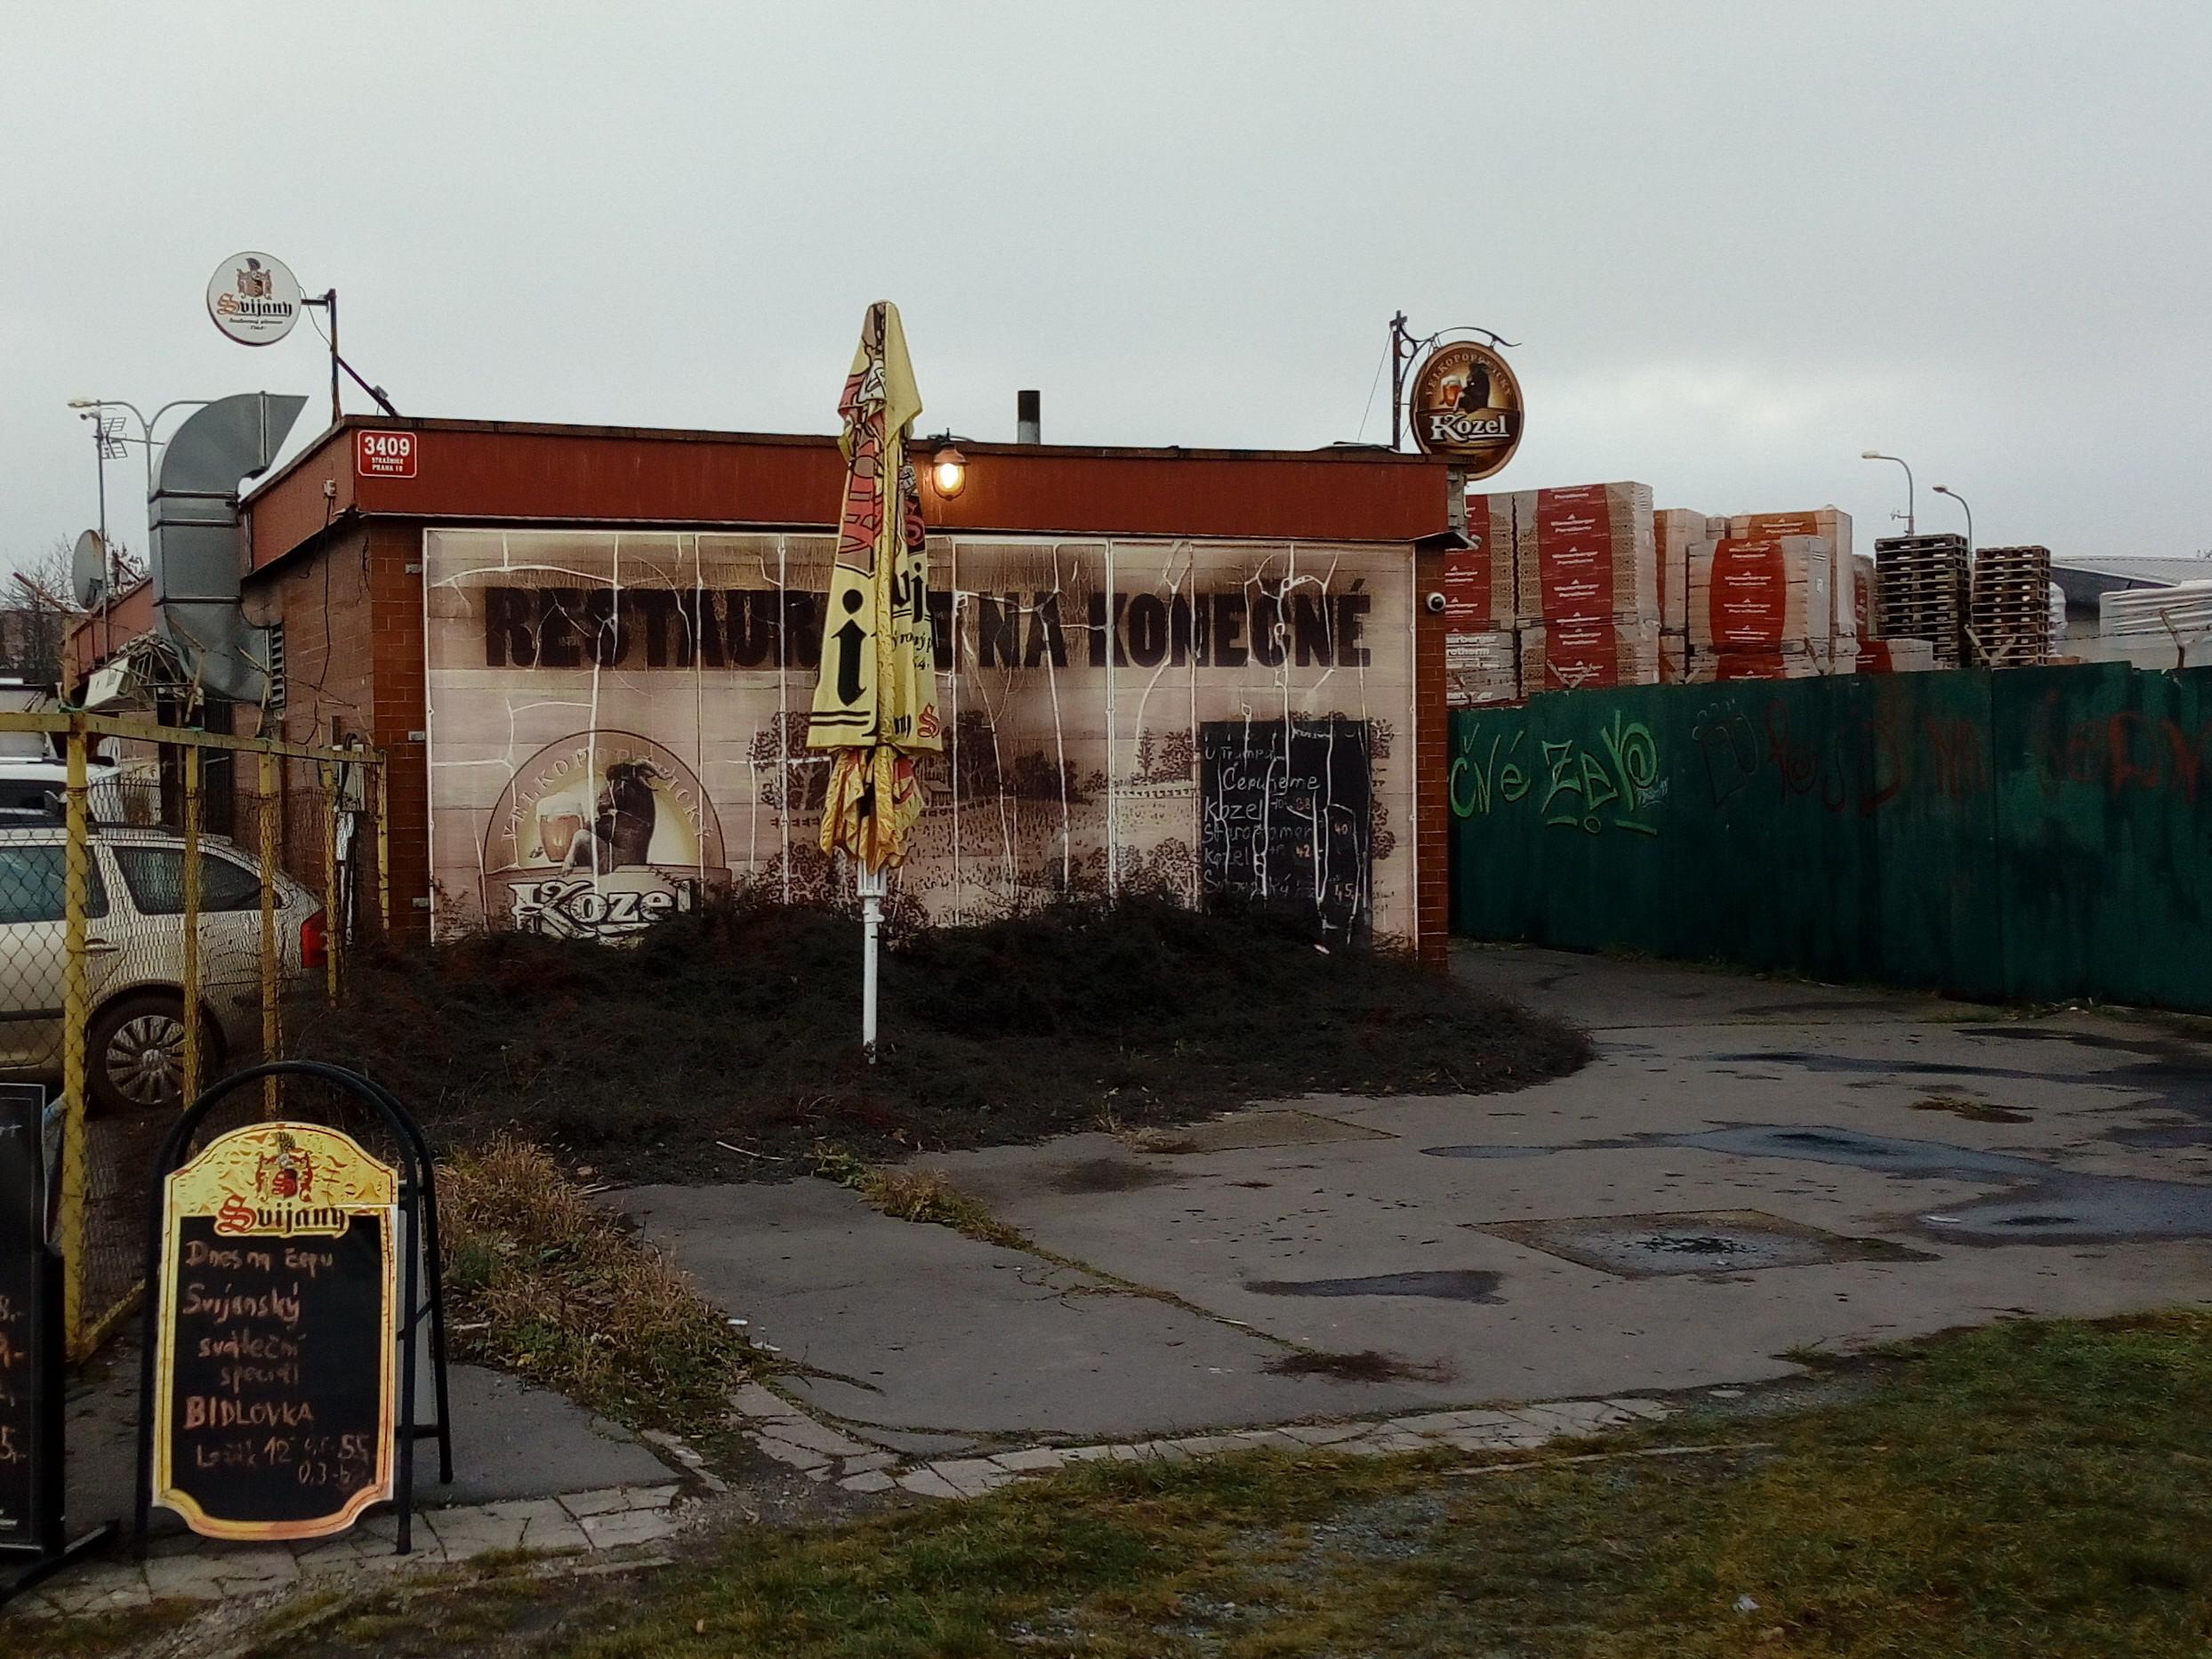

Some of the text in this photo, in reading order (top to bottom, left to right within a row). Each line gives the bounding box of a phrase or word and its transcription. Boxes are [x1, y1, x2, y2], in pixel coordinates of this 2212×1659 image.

[216, 293, 292, 318] Svijany
[1429, 414, 1509, 442] Kozel
[365, 436, 410, 456] 3409
[979, 590, 1067, 668] NA
[1204, 796, 1262, 821] Kozel
[508, 879, 691, 939] Kozel
[217, 1193, 345, 1235] Svijany
[184, 1240, 243, 1269] Dnes
[182, 1395, 315, 1430] BIDLOVKA
